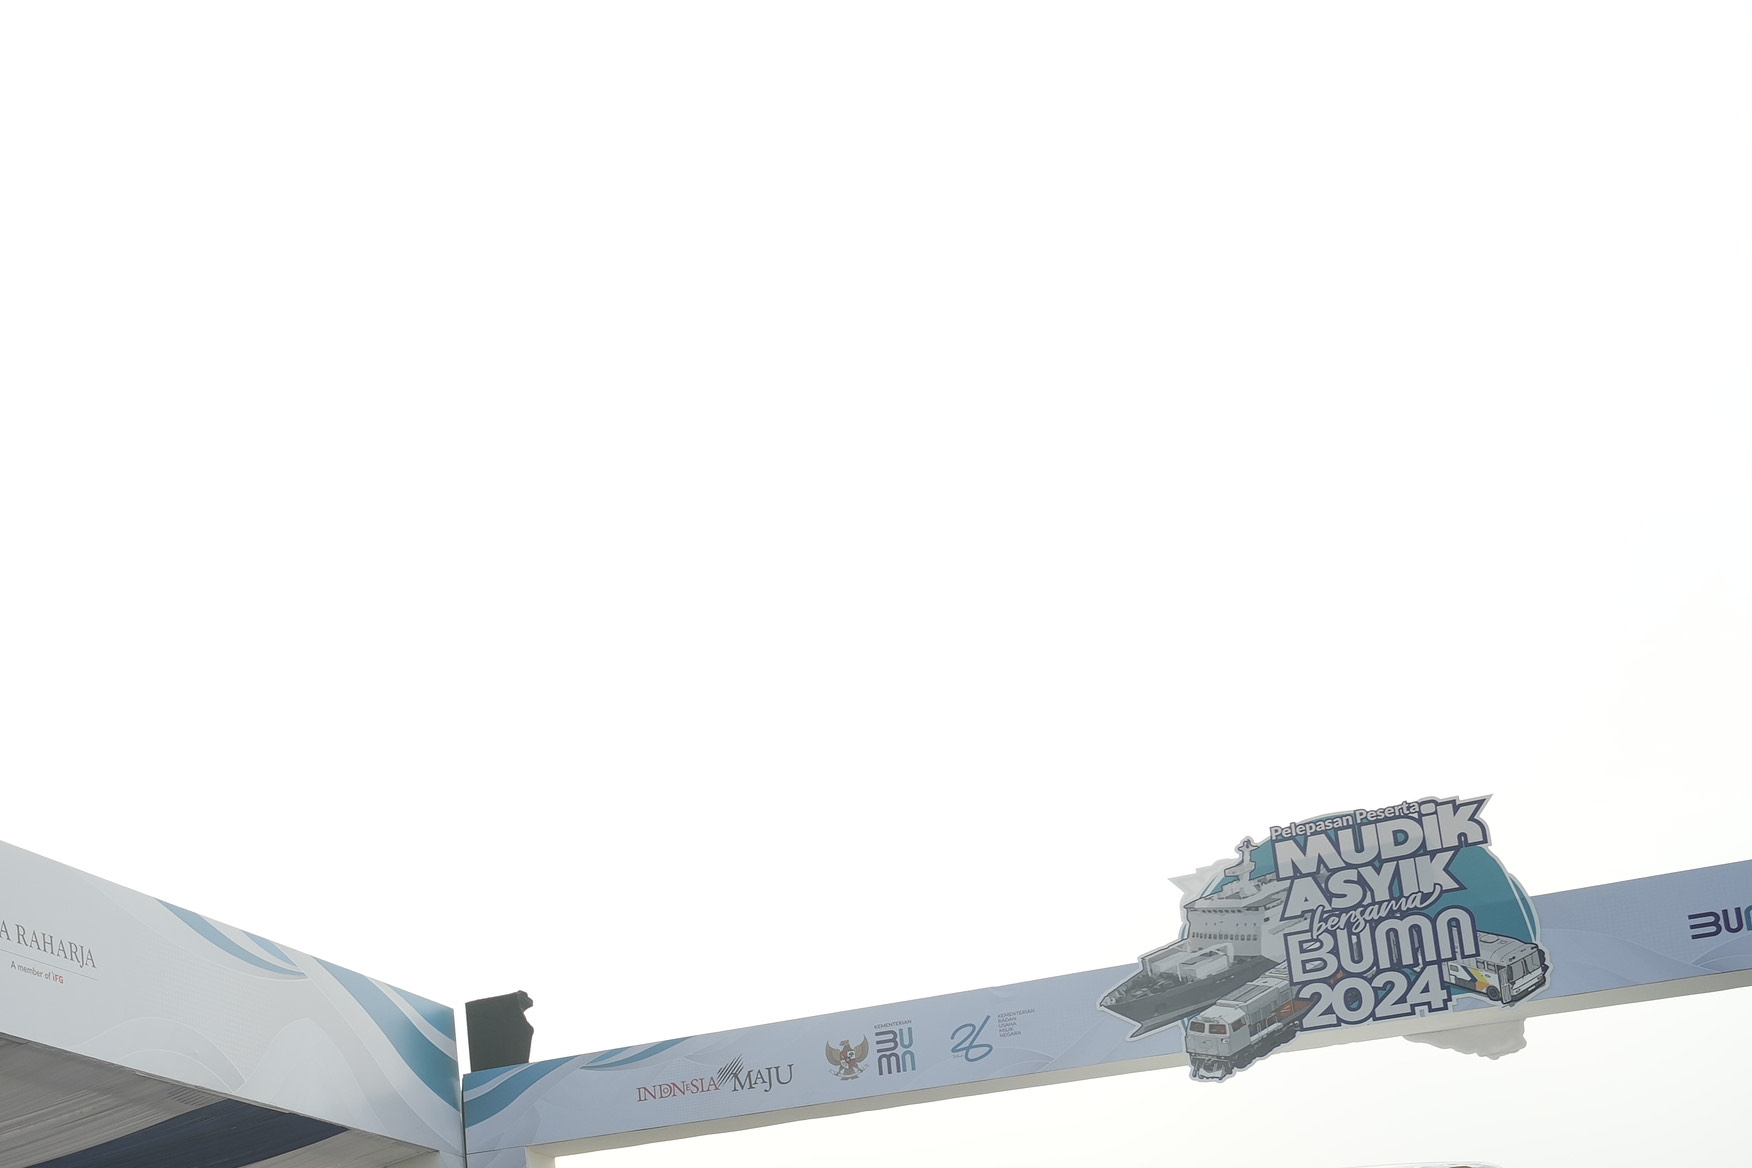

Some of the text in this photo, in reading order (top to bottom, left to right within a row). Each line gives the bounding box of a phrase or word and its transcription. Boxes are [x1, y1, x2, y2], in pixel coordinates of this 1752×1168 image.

[1269, 800, 1421, 841] Pelepasan Peserta
[1283, 849, 1466, 921] ASYIK
[1310, 884, 1442, 940] bersama
[10, 960, 52, 980] A member of
[16, 923, 97, 970] RAHARJA
[1299, 966, 1451, 1031] 2024
[874, 1019, 912, 1029] KEMENTERIAN
[950, 1015, 994, 1063] 26
[732, 1063, 794, 1094] MAJU
